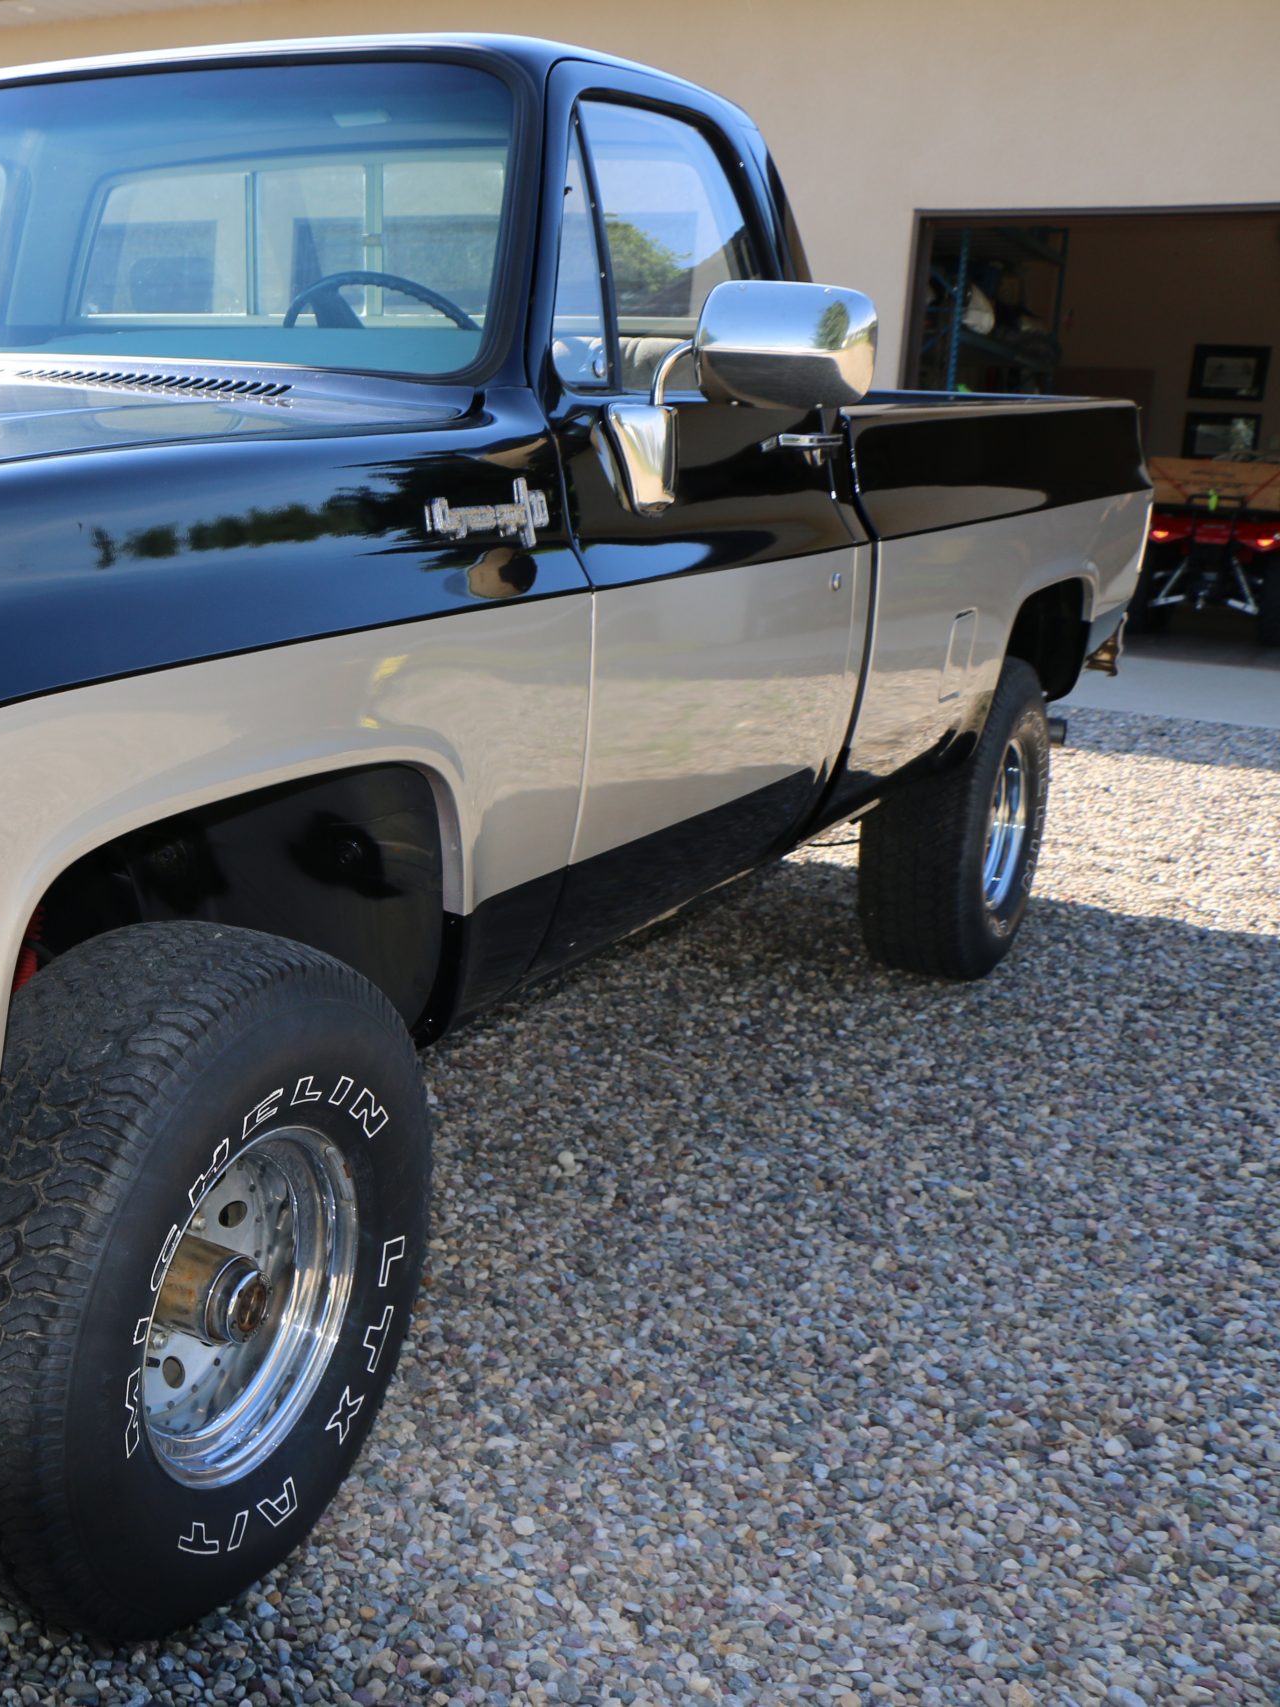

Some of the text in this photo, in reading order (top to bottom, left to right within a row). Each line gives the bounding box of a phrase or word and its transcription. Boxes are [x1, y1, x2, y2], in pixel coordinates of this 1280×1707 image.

[125, 1075, 390, 1459] MICHELIN
[177, 1235, 407, 1556] LTX A/T
